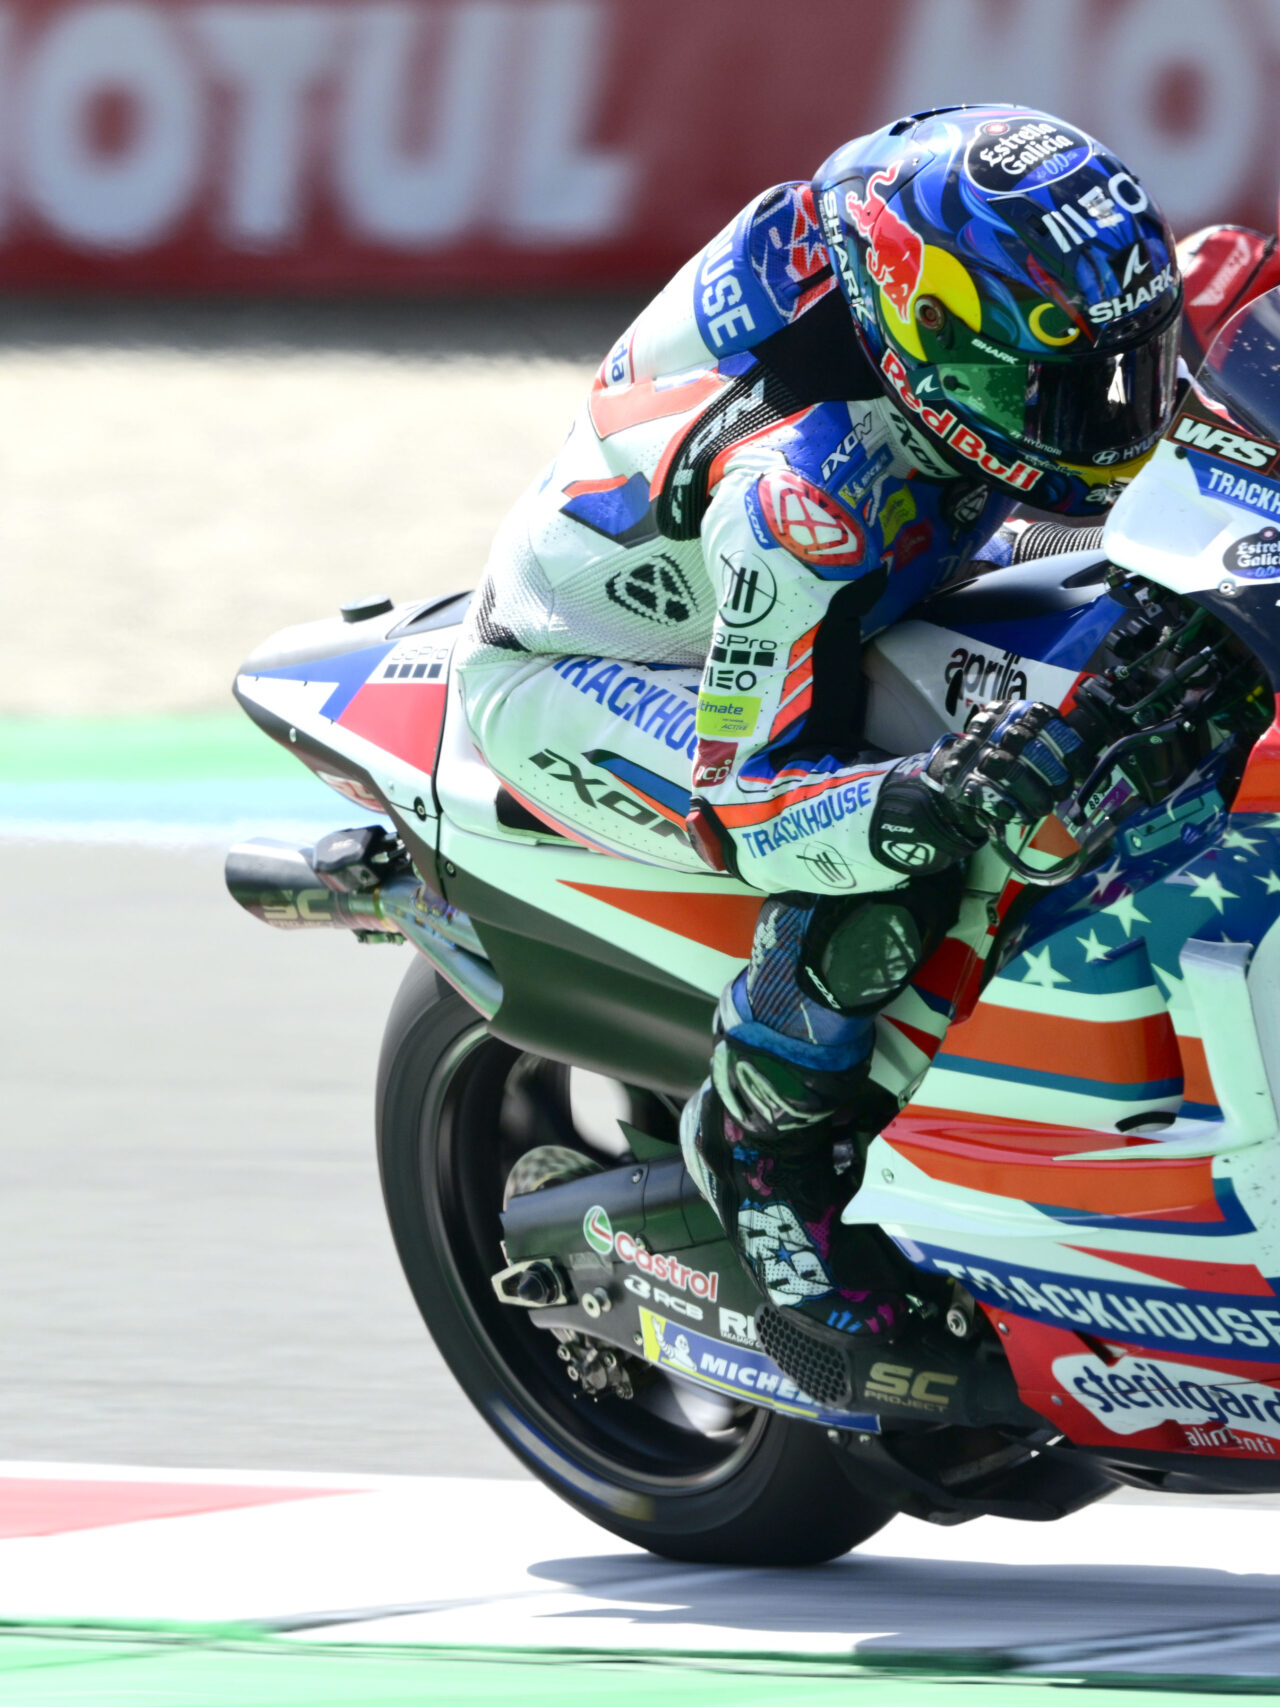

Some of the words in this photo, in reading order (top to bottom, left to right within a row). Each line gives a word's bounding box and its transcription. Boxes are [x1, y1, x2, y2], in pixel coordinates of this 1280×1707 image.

[0, 2, 650, 258] OTUL
[979, 122, 1057, 167] Estrella
[1001, 132, 1074, 175] Galicia
[823, 190, 876, 324] SHARK
[1089, 263, 1174, 323] SHARK
[971, 338, 1019, 365] SHARK
[880, 348, 957, 438] Red
[947, 424, 1044, 491] Bull
[1173, 418, 1277, 468] WRS
[945, 648, 1028, 701] aprilia
[742, 781, 872, 859] TRACKHOUSE
[614, 1231, 719, 1303] Castrol
[653, 1288, 704, 1320] RCB
[864, 1389, 947, 1412] PROJECT
[865, 1362, 958, 1404] SC
[1186, 1426, 1276, 1455] alimenti
